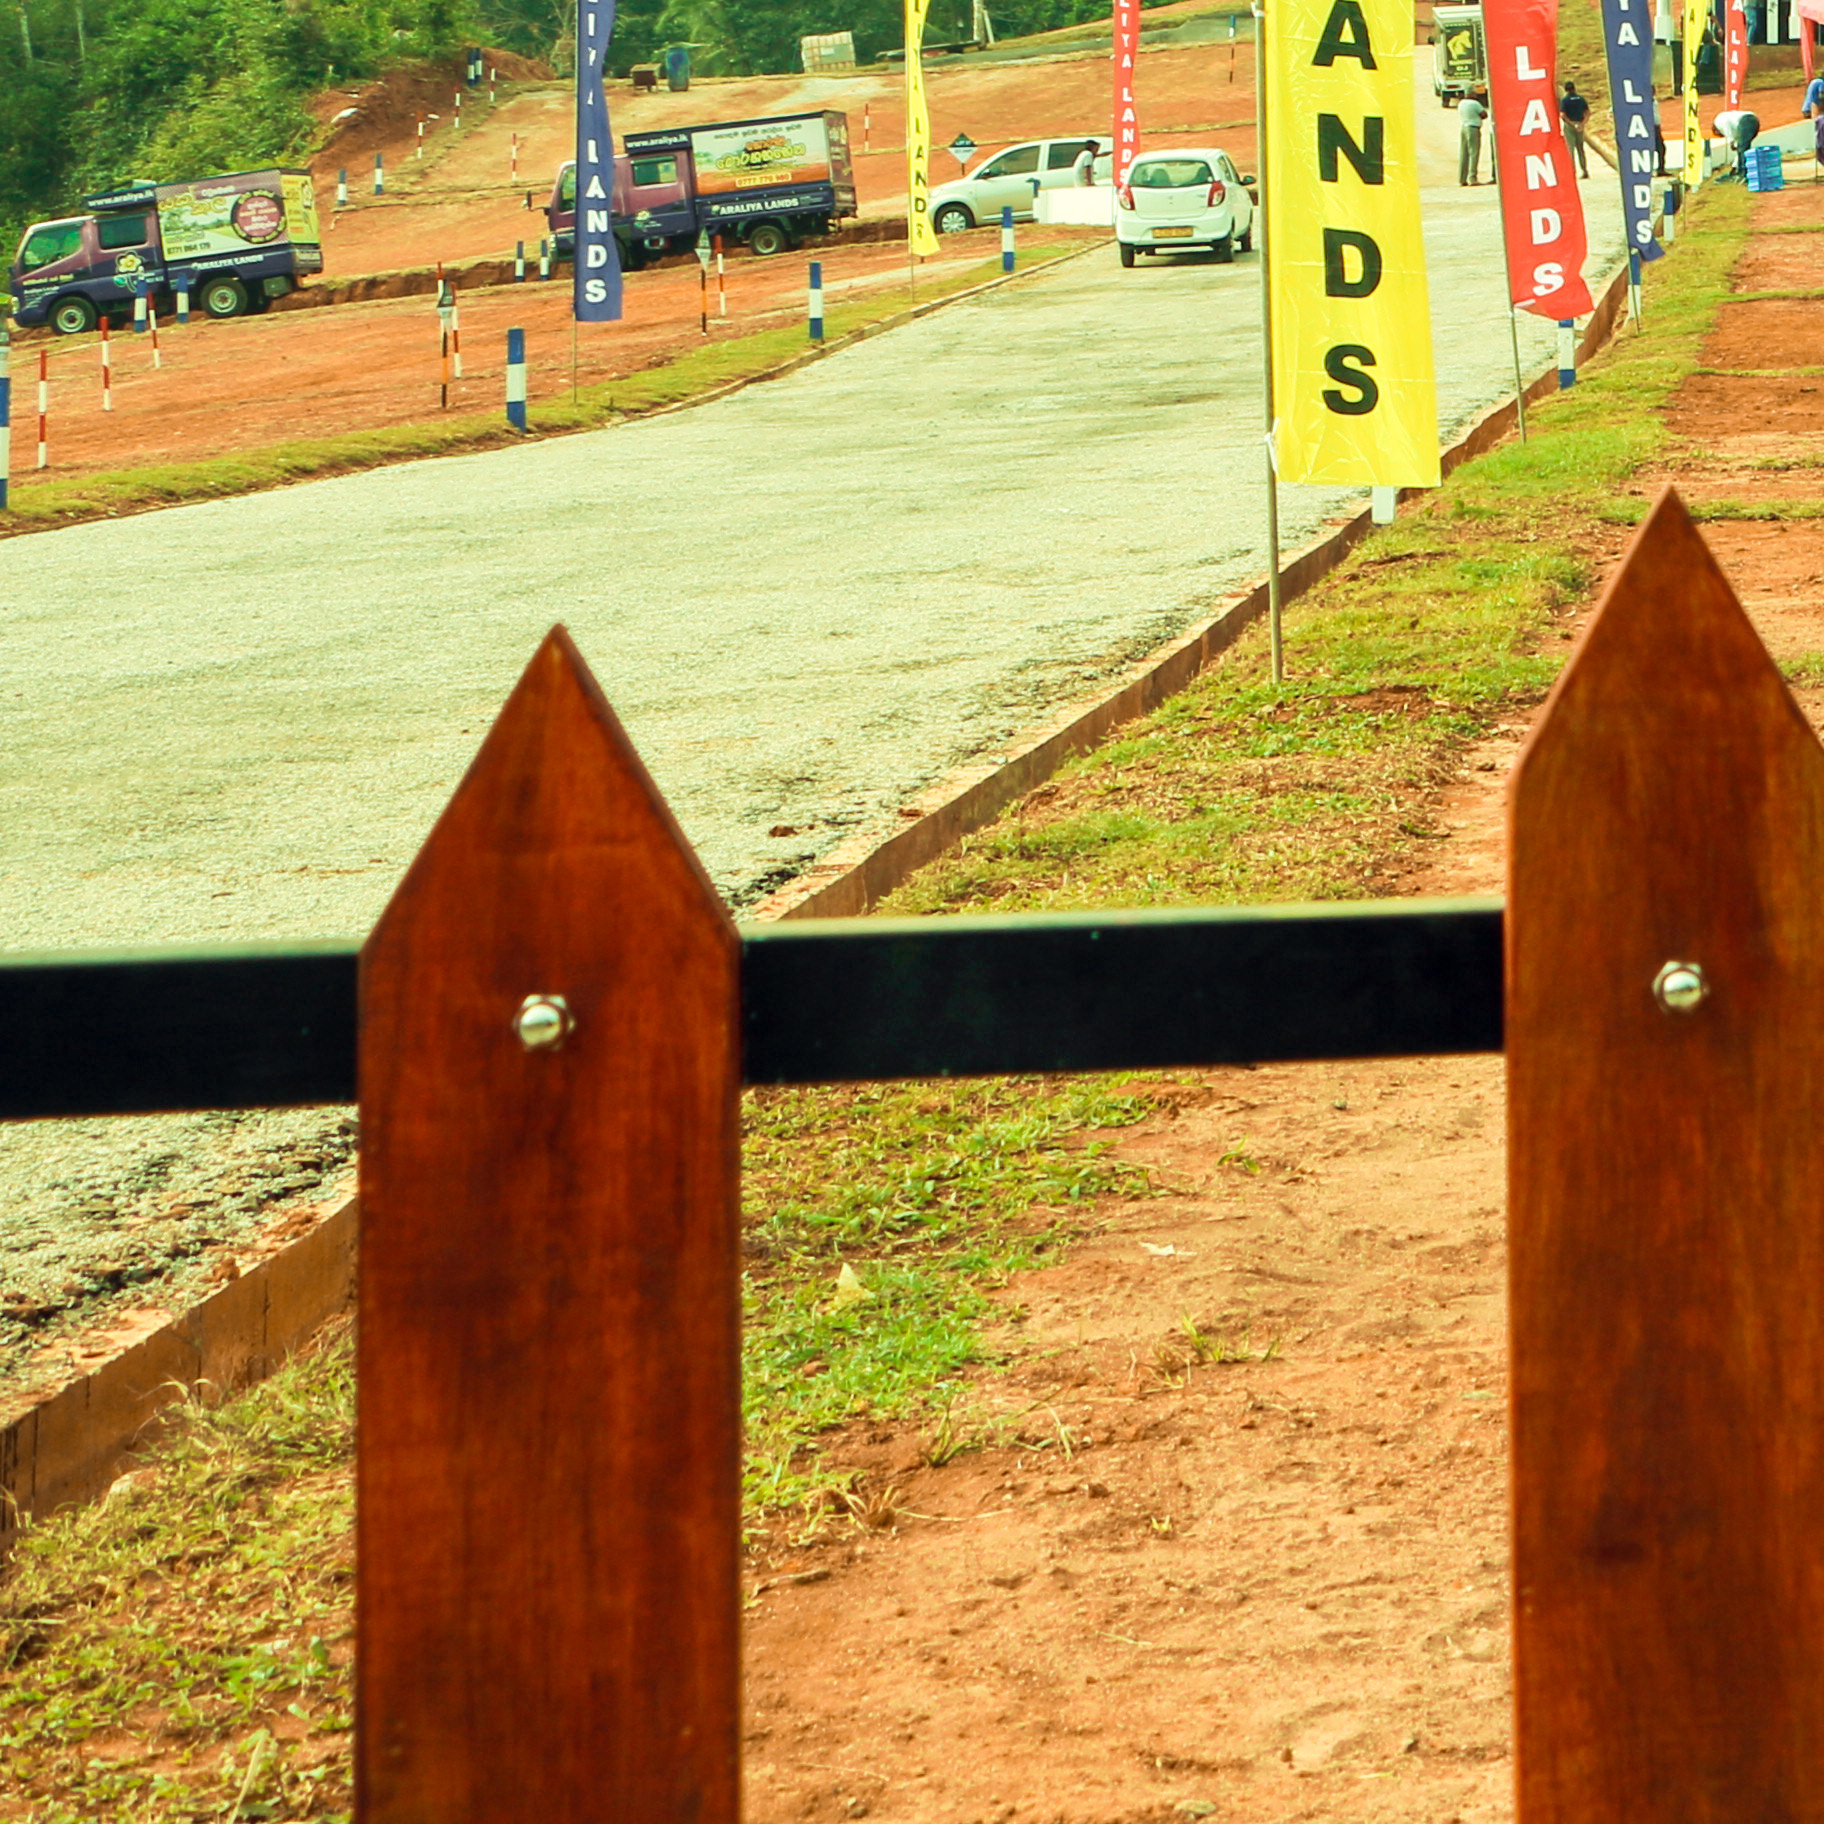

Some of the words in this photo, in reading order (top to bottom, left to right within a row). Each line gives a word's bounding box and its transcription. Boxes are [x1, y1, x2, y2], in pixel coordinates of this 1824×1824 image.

[1515, 44, 1565, 297] LANDS
[1623, 78, 1654, 245] LANDS
[1686, 48, 1700, 170] LANDS
[585, 138, 610, 304] LANDS
[719, 201, 763, 216] ARALIYA
[765, 197, 799, 211] LANDS
